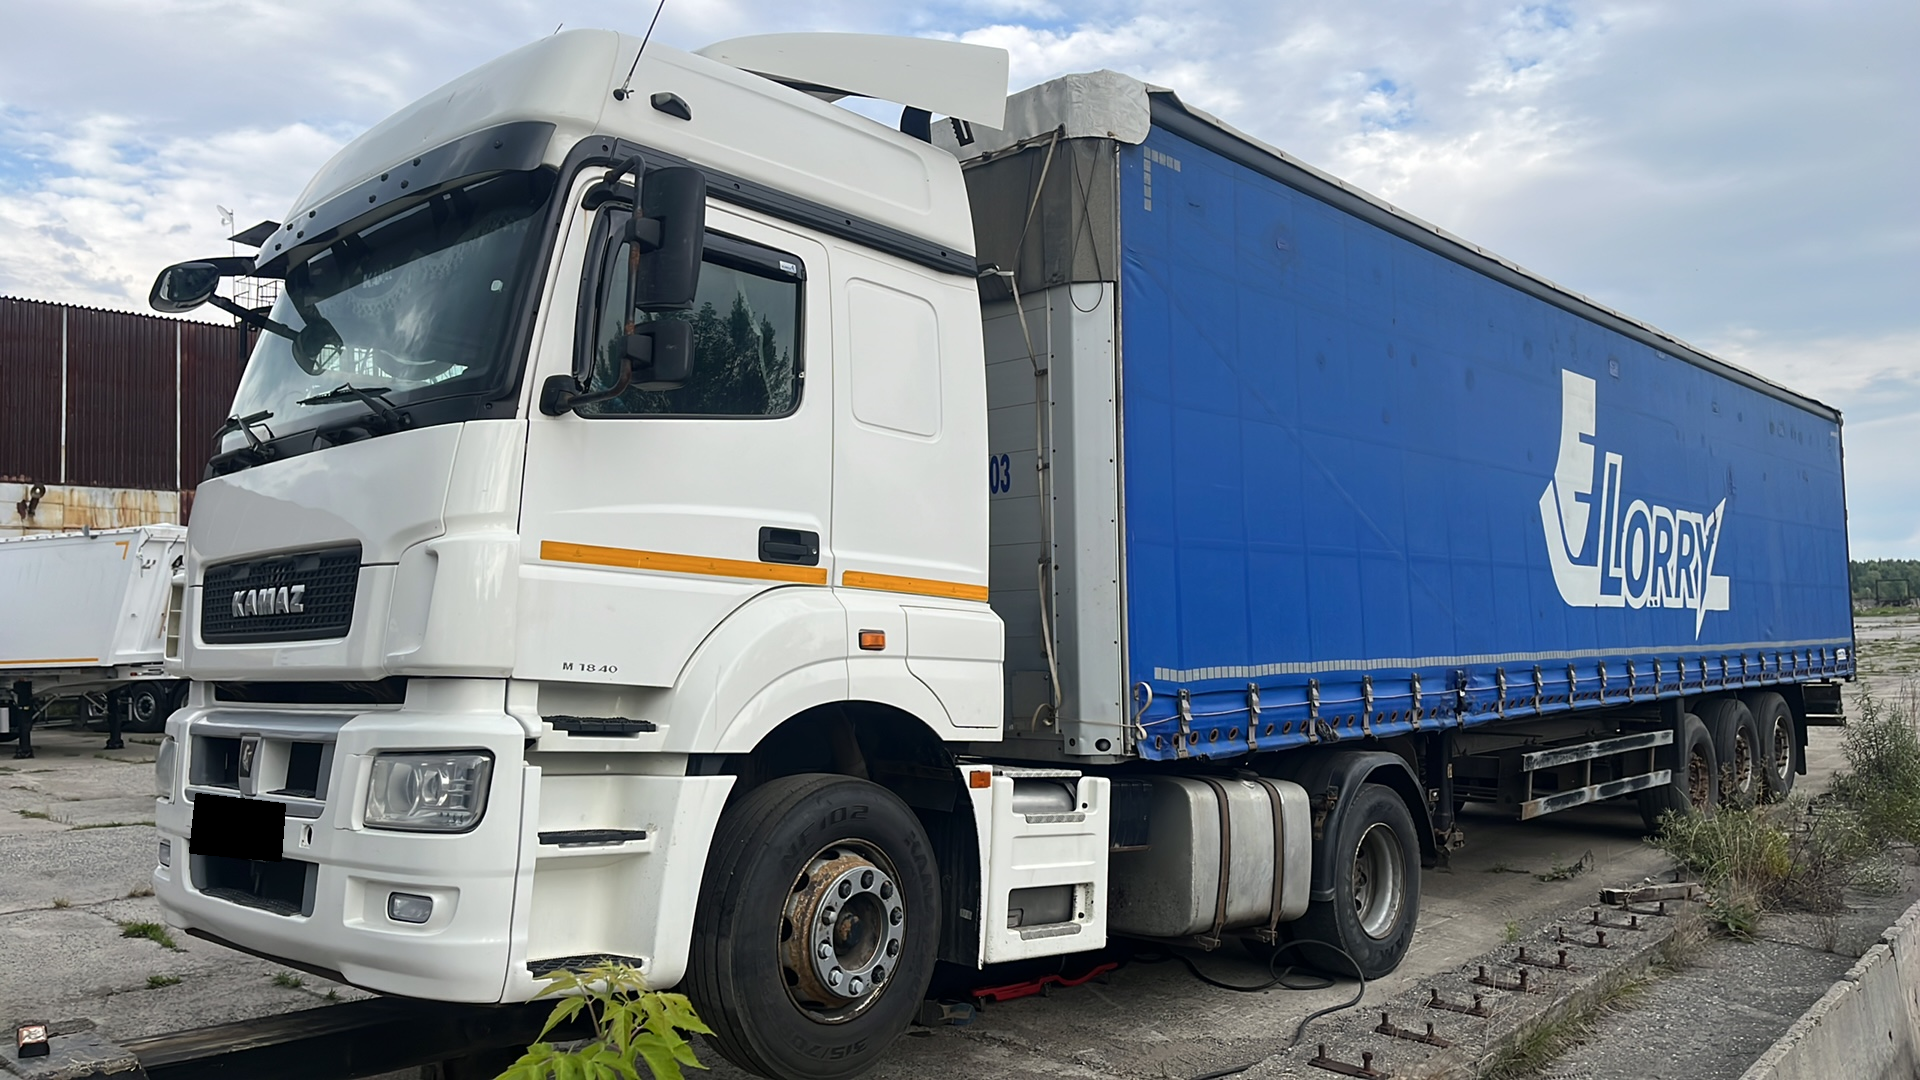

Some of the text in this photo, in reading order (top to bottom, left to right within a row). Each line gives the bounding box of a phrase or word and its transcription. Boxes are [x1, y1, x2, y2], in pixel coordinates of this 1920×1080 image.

[989, 453, 1011, 494] 03
[231, 584, 306, 618] KAMAZ
[562, 662, 574, 671] M
[820, 804, 869, 832] 102
